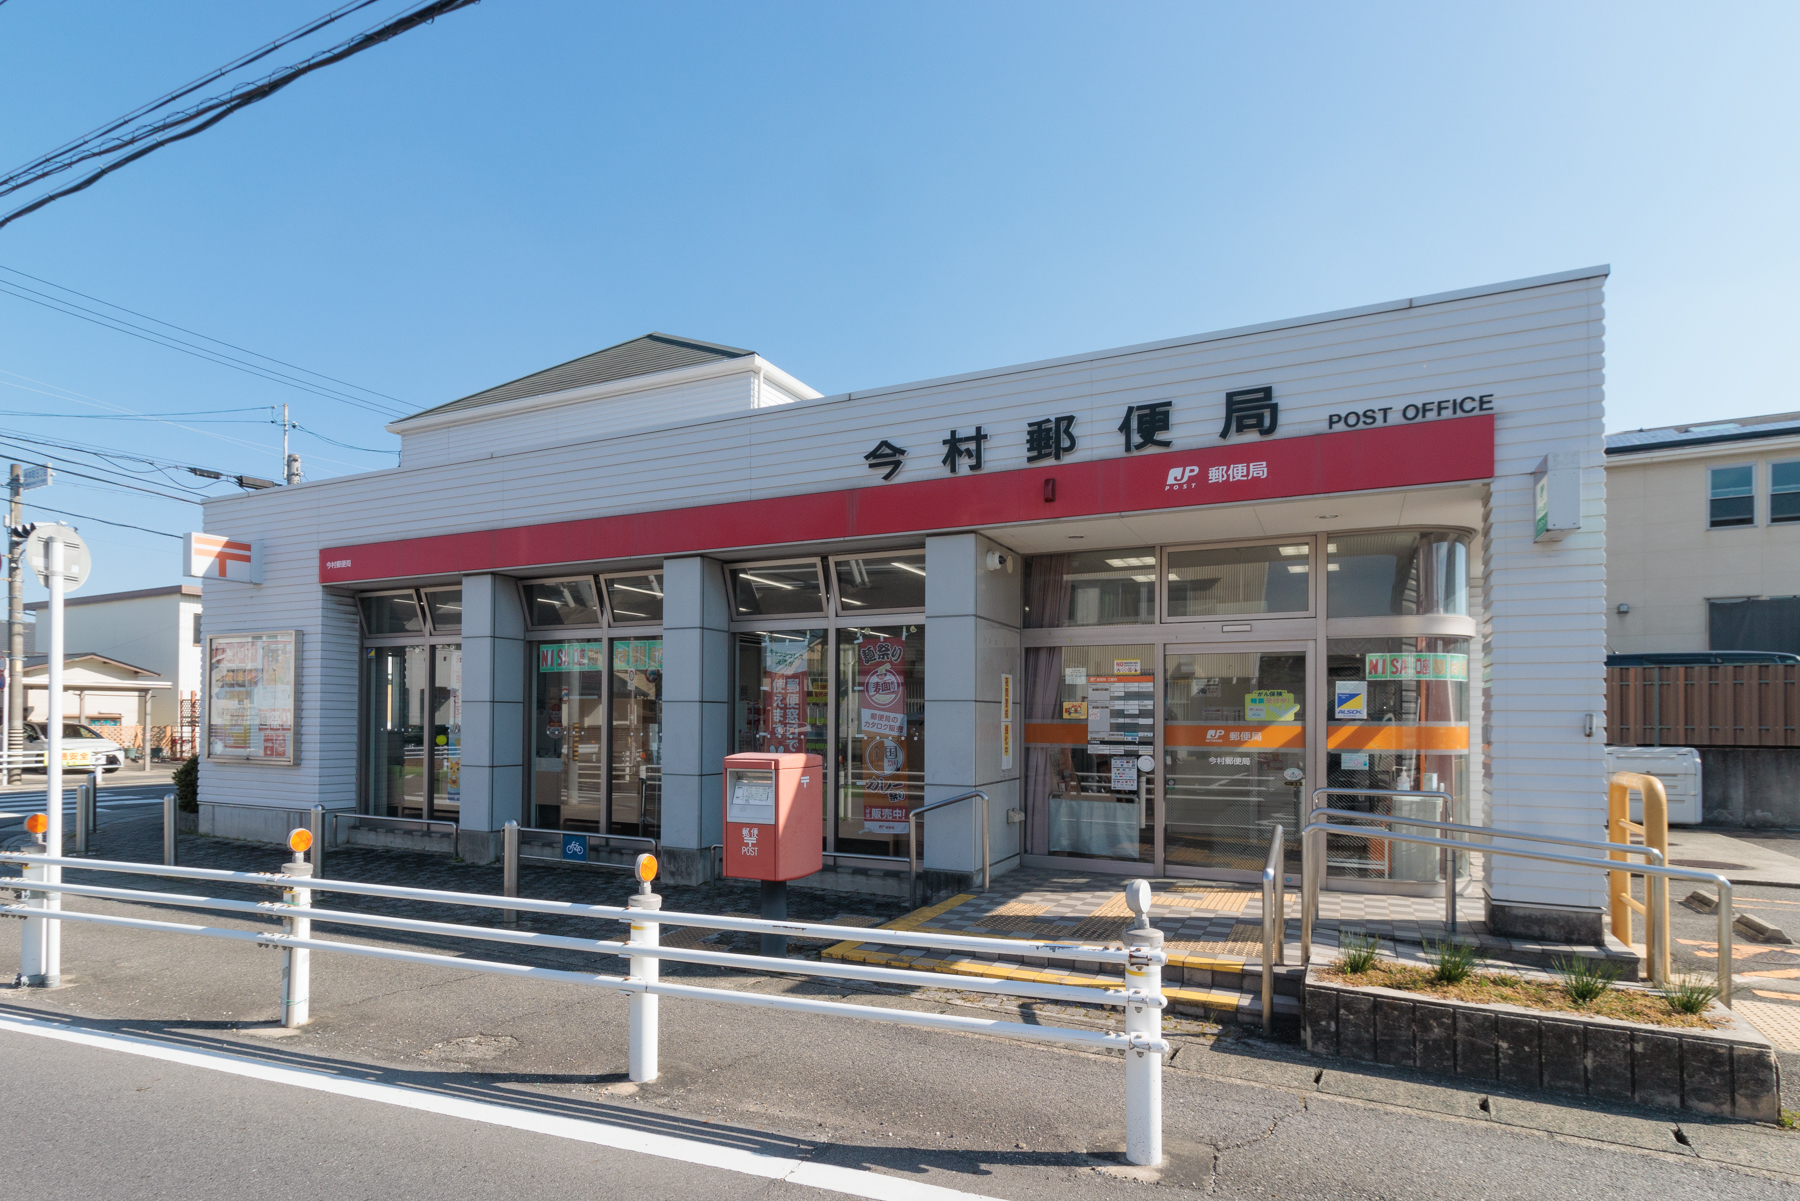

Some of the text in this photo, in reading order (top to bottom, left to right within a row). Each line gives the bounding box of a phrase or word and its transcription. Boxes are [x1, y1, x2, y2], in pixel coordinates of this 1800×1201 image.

[1328, 394, 1494, 430] POST OFFICE
[863, 386, 1279, 481] 今村郵便局
[1208, 461, 1268, 484] 郵便局
[1165, 483, 1196, 491] POST
[326, 560, 352, 569] 今村郵便局
[860, 643, 903, 665] 麺祭り
[773, 678, 785, 737] 使えます
[786, 678, 799, 752] 郵便窓口で
[870, 712, 898, 724] 郵便局の
[864, 721, 904, 734] カタログ販売
[1229, 731, 1262, 742] 郵便局
[62, 752, 89, 760] 通安全
[1208, 756, 1251, 766] 今村郵便局
[871, 808, 905, 820] 販売中!
[742, 827, 759, 838] 郵便
[741, 846, 759, 856] POST
